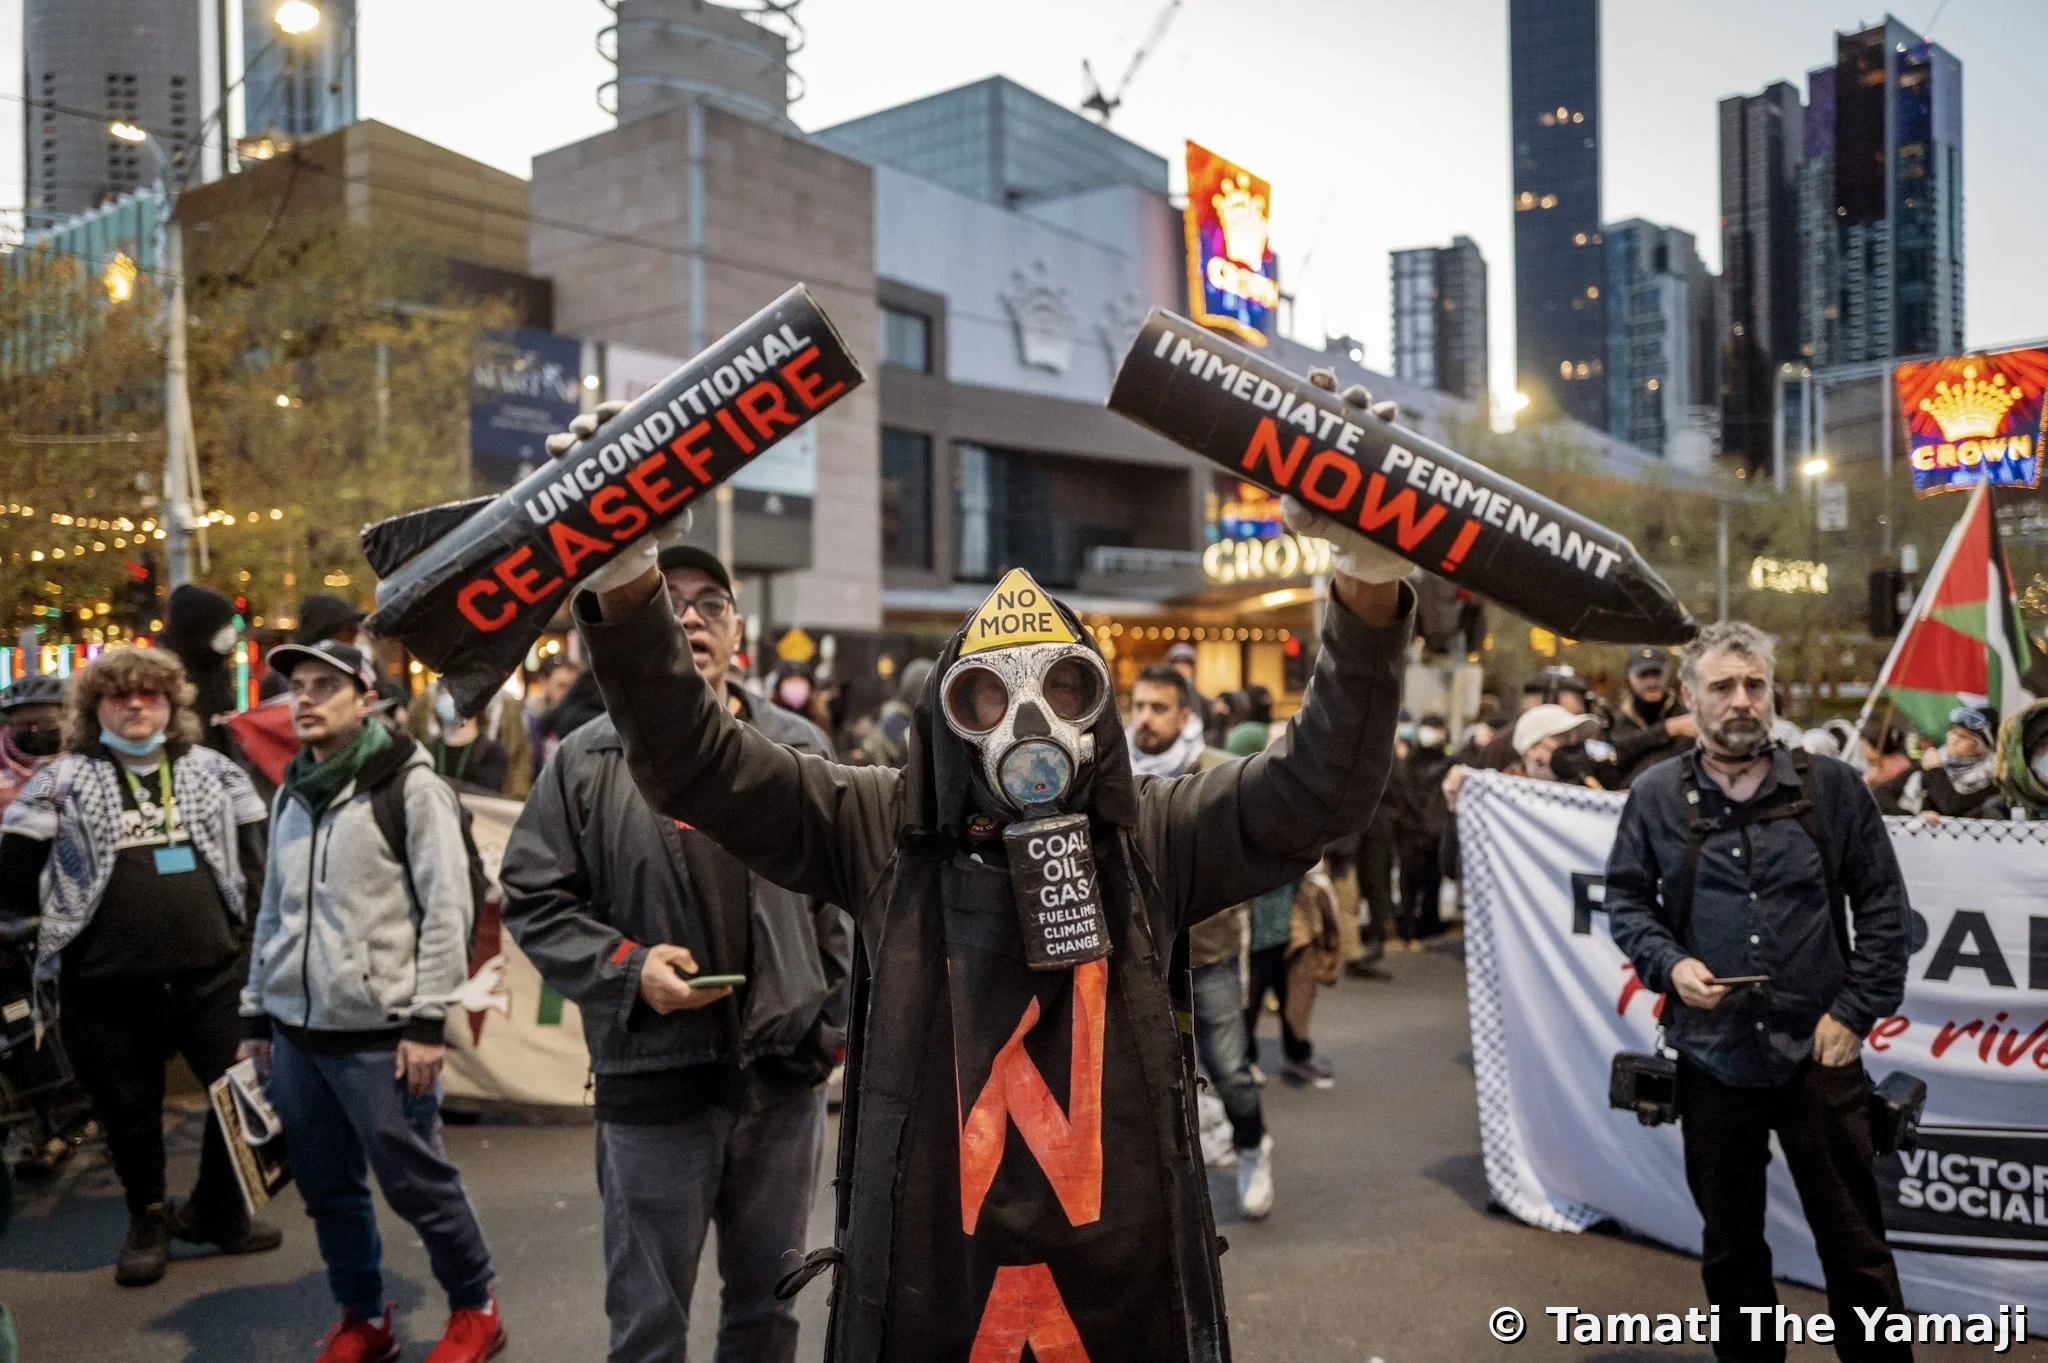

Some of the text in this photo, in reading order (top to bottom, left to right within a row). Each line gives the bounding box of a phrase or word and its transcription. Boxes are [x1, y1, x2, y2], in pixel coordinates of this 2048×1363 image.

[524, 323, 813, 526] UNCONDITIONAL
[1154, 330, 1622, 580] IMMEDIATE PERMENANT
[1911, 434, 2033, 471] CROWN
[456, 345, 846, 632] CEASEFIRE
[997, 589, 1037, 610] NO
[980, 613, 1053, 638] MORE
[1028, 830, 1088, 860] COAL
[1043, 857, 1083, 882] OIL
[1040, 878, 1091, 908] GAS
[1038, 903, 1096, 925] FUELLING
[1044, 918, 1096, 939] CLIMATE
[1046, 933, 1100, 955] CHANGE
